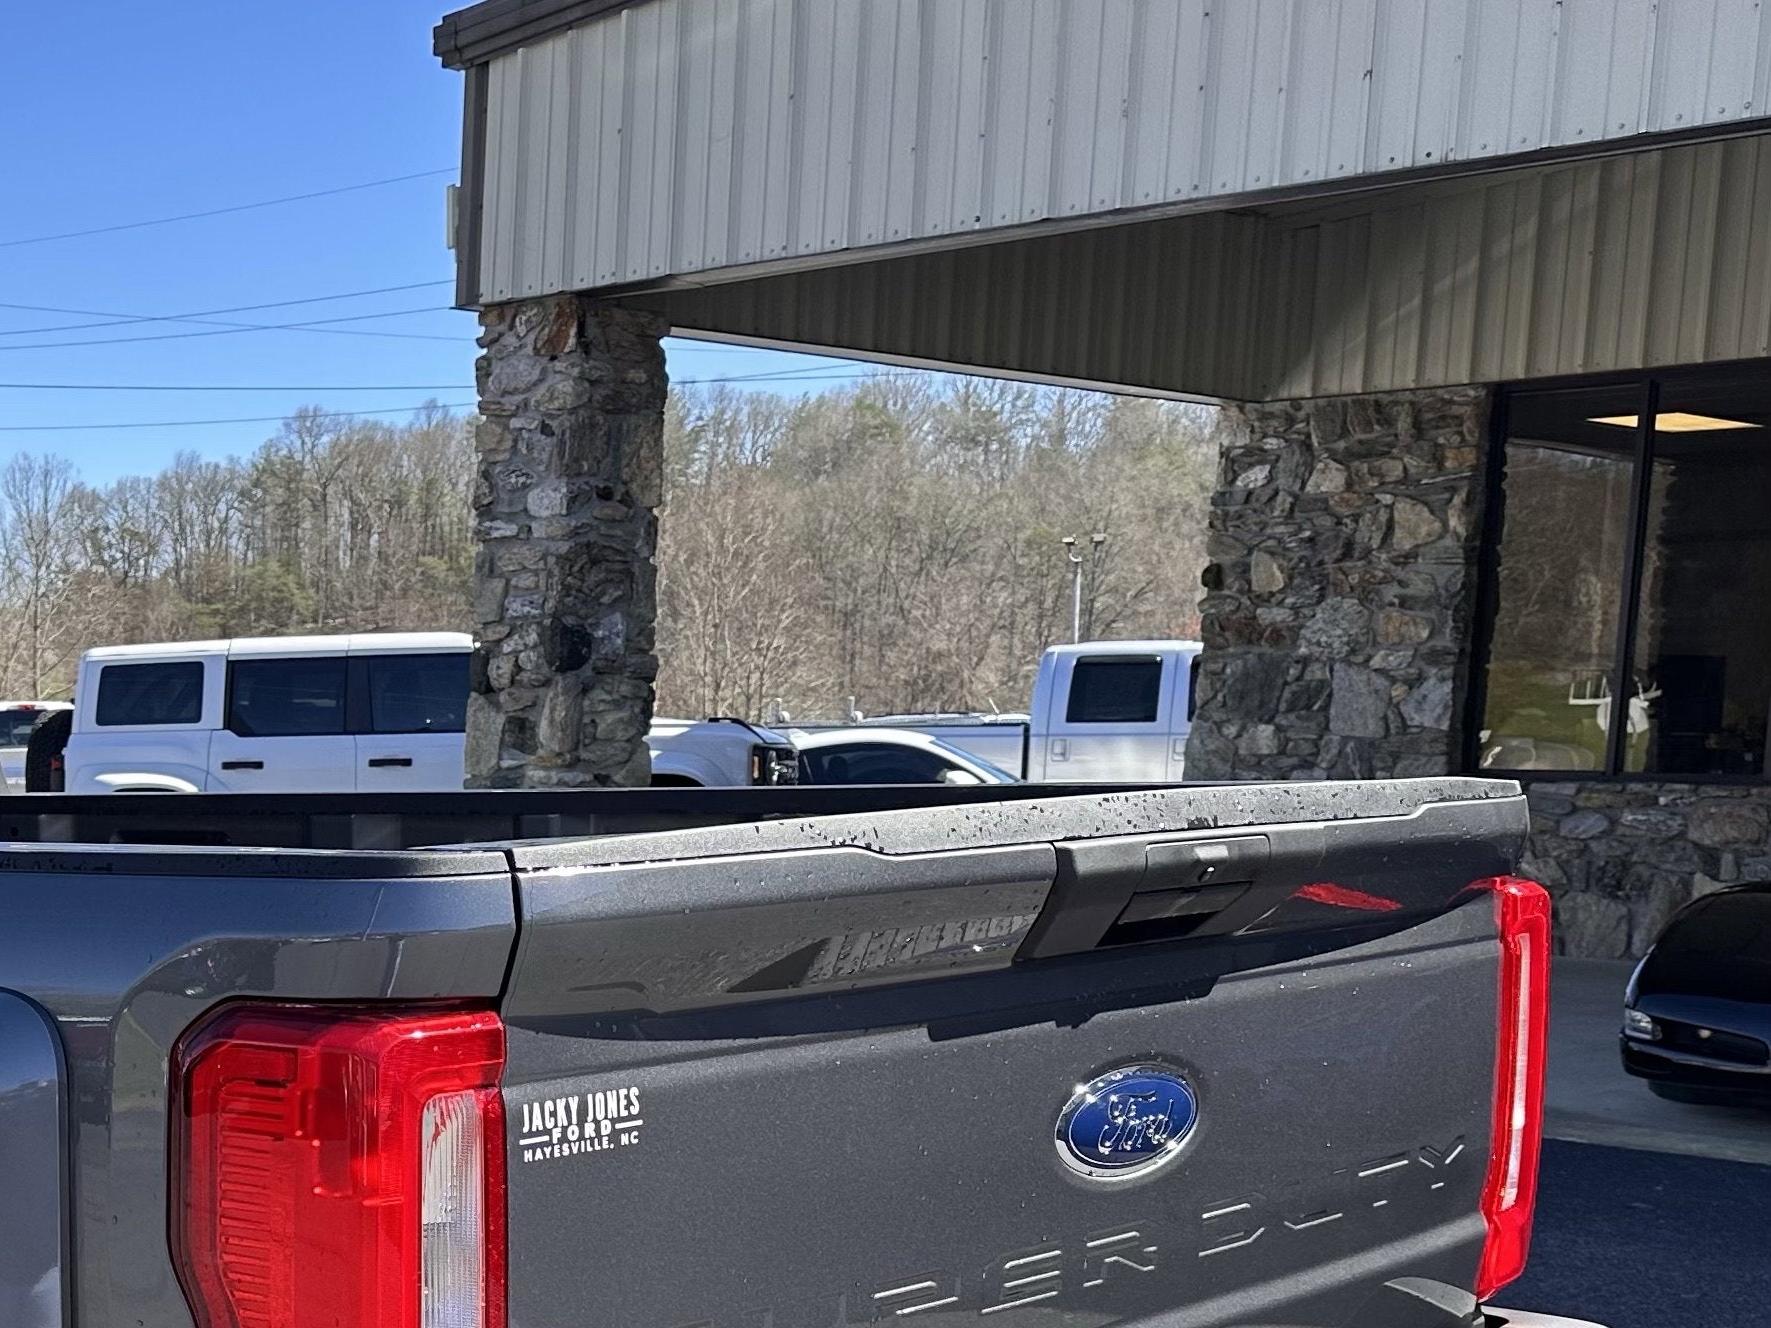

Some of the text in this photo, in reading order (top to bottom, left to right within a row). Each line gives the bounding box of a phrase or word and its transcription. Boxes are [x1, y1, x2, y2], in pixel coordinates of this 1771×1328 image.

[522, 1086, 640, 1133] JACKY JONES
[1098, 1090, 1174, 1155] Ford
[524, 1131, 639, 1163] HAYESVILLE, NC
[552, 1119, 612, 1144] FORD
